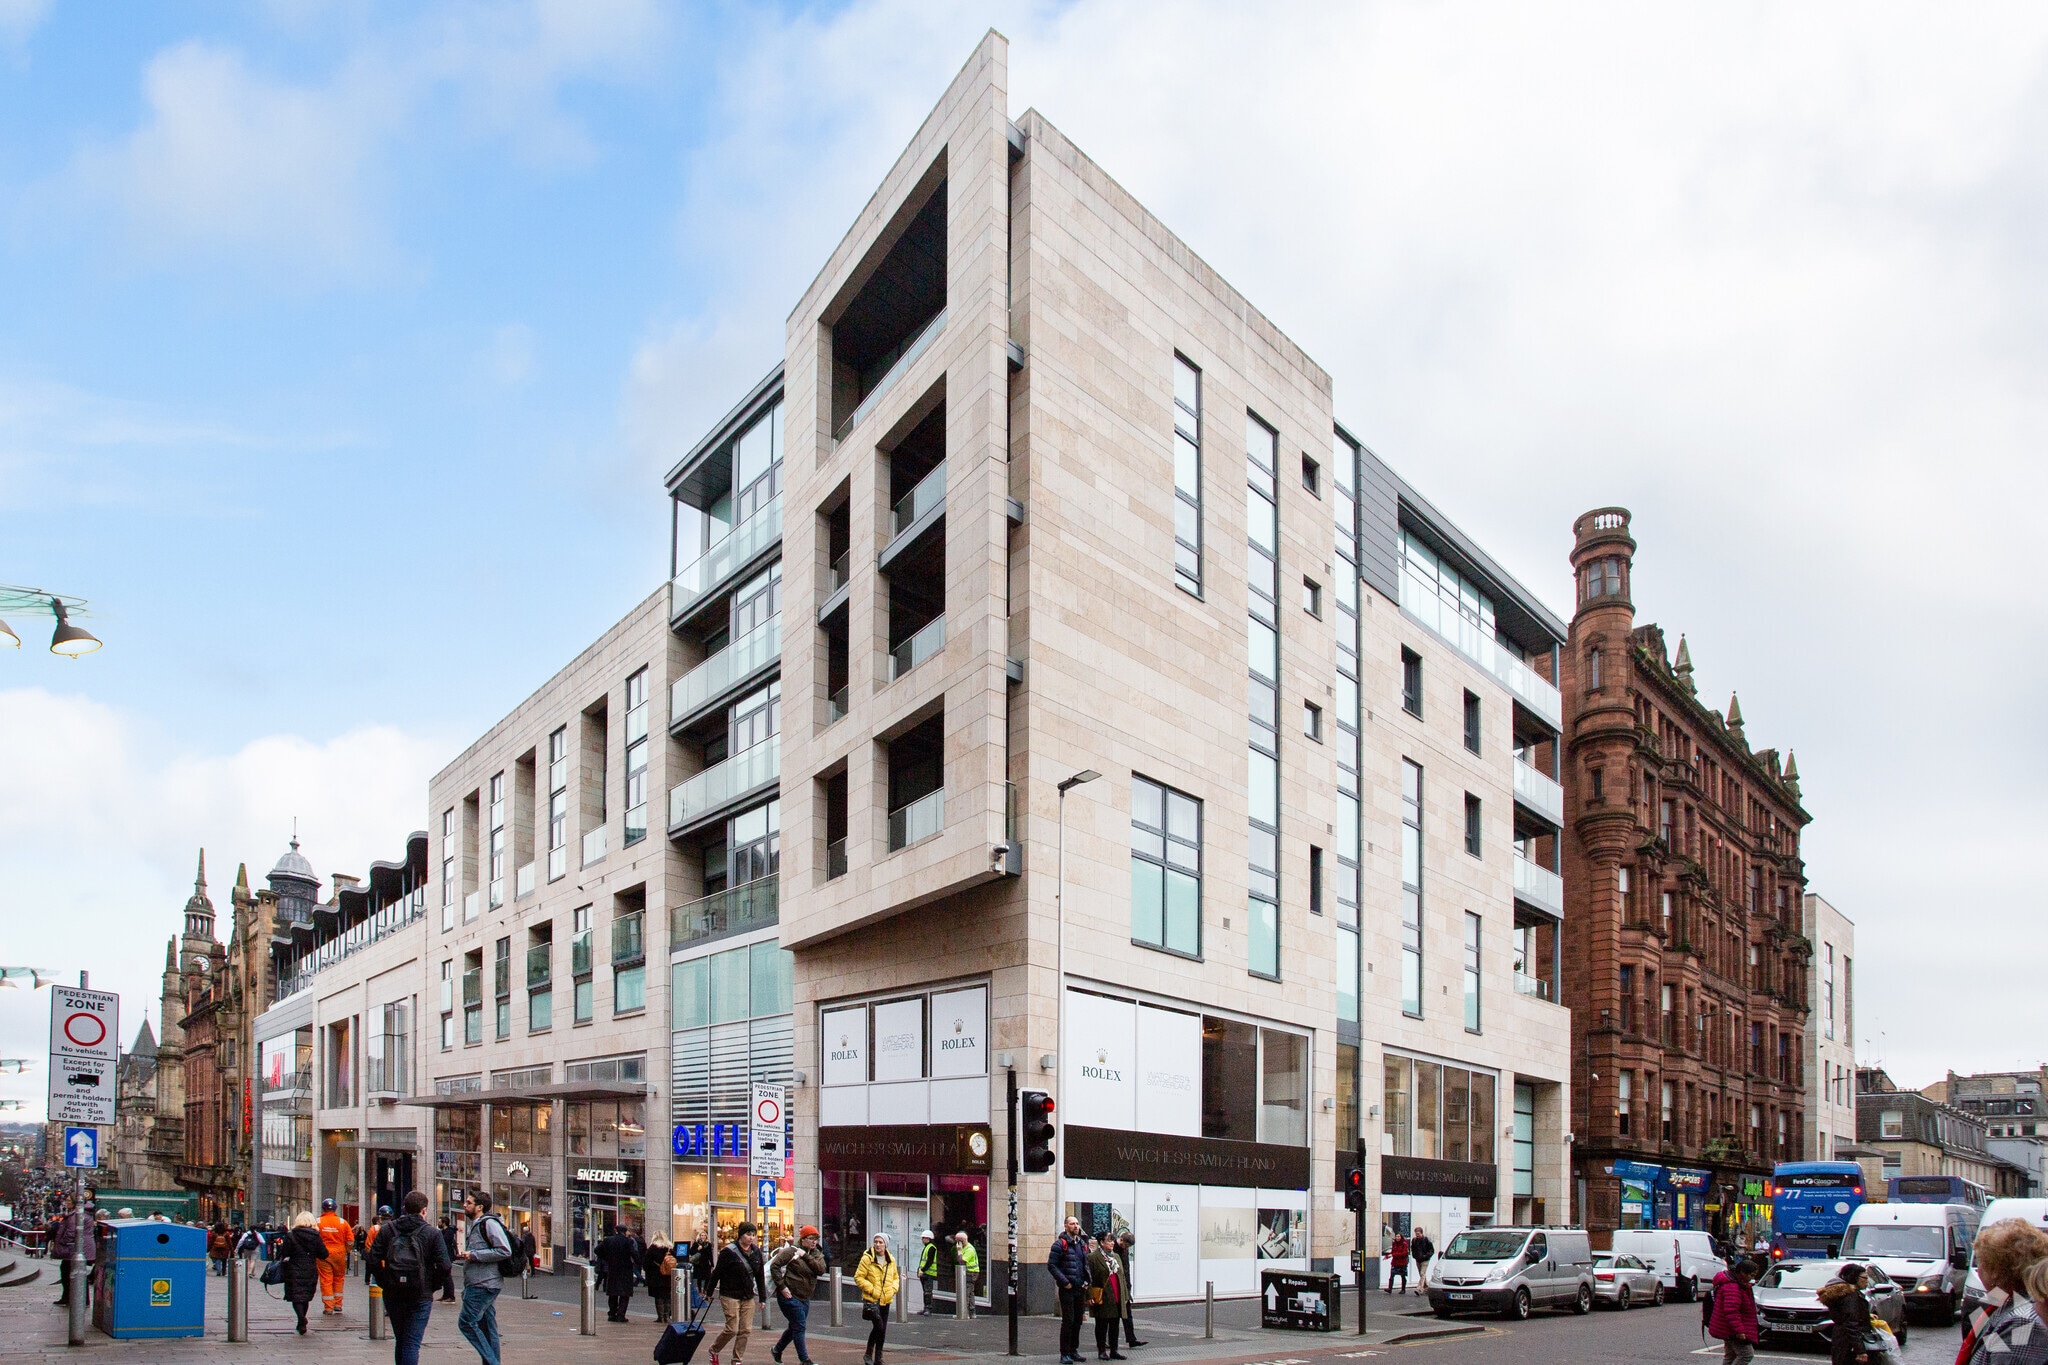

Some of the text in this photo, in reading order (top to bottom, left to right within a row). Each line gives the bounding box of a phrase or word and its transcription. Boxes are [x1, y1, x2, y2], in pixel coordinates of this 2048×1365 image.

[58, 989, 114, 1002] PEDESTRIAN
[65, 998, 105, 1012] ZONE
[941, 1036, 976, 1050] ROLEX
[75, 1047, 108, 1056] vehicles
[831, 1049, 858, 1061] ROLEX
[63, 1058, 91, 1066] Except
[63, 1065, 92, 1073] loading
[1081, 1065, 1122, 1082] ROLEX
[754, 1083, 783, 1092] PEDESTRIAN
[758, 1090, 779, 1099] ZONE
[67, 1100, 99, 1108] outwith
[1117, 1147, 1183, 1165] WATCHES
[1194, 1153, 1276, 1170] SWITZERLAND
[506, 1160, 530, 1178] FATFACE
[577, 1168, 628, 1184] SKECHERS
[1784, 1189, 1801, 1199] 77
[1156, 1204, 1180, 1212] ROLEX
[1812, 1205, 1823, 1214] 77
[1288, 1278, 1307, 1286] Repairs
